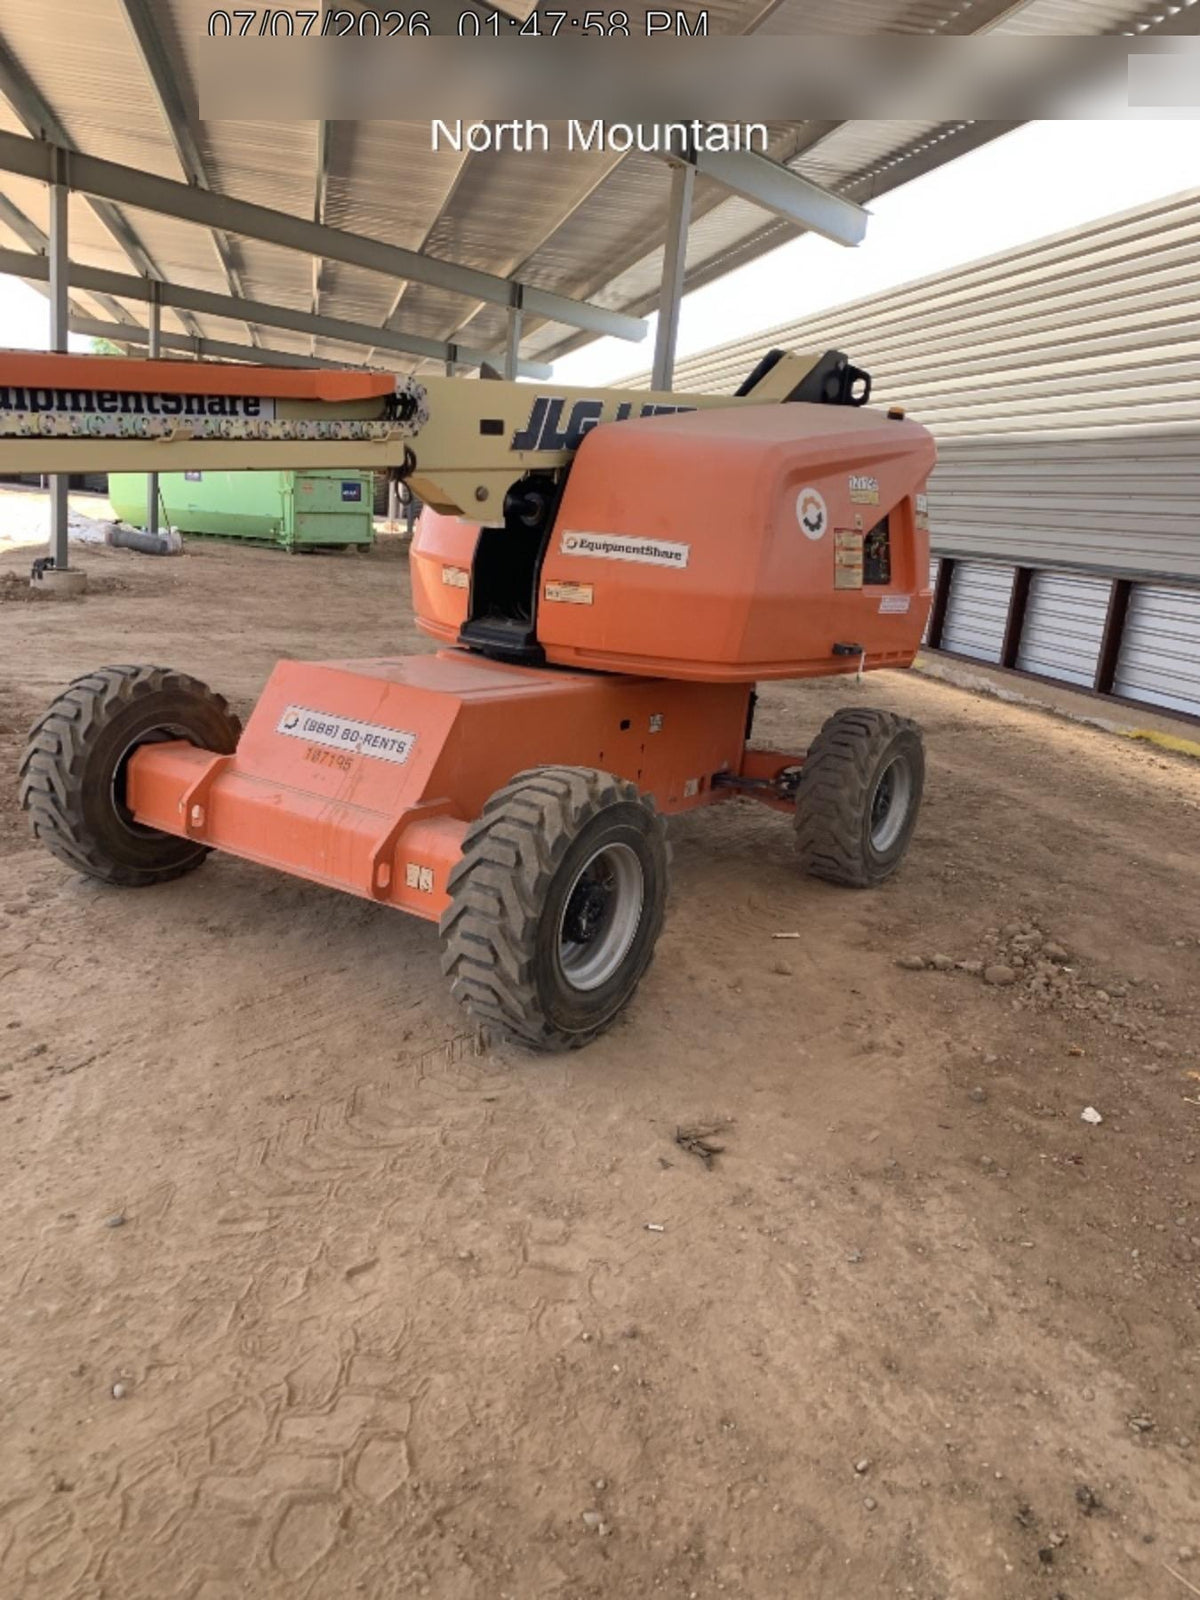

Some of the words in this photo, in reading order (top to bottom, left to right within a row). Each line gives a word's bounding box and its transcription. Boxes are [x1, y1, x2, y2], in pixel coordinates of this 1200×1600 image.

[579, 538, 682, 561] EquipmentShare
[303, 717, 339, 739] (888)
[341, 727, 407, 754] 80-RENTS
